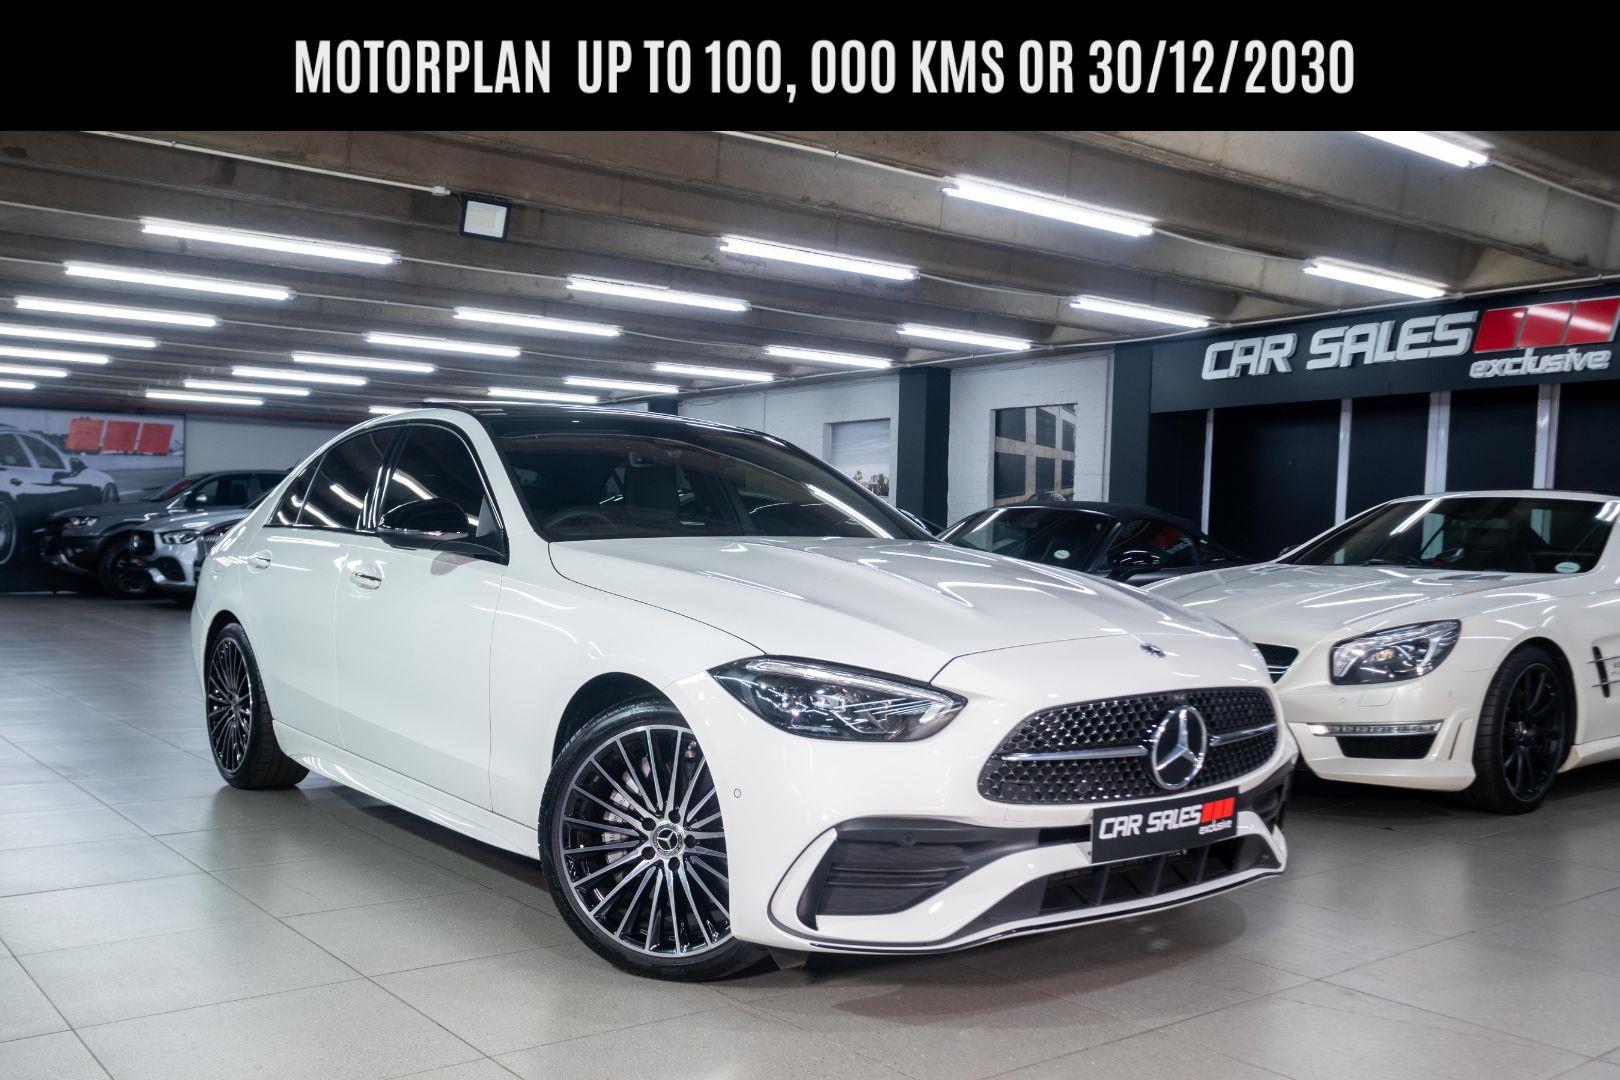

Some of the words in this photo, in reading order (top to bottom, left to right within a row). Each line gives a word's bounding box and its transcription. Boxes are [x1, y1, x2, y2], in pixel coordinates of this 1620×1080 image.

[1201, 332, 1297, 381] CAR
[1305, 310, 1479, 370] SALES
[1469, 347, 1612, 379] exclusive
[1098, 814, 1143, 840] CAR
[1146, 804, 1203, 834] SALES
